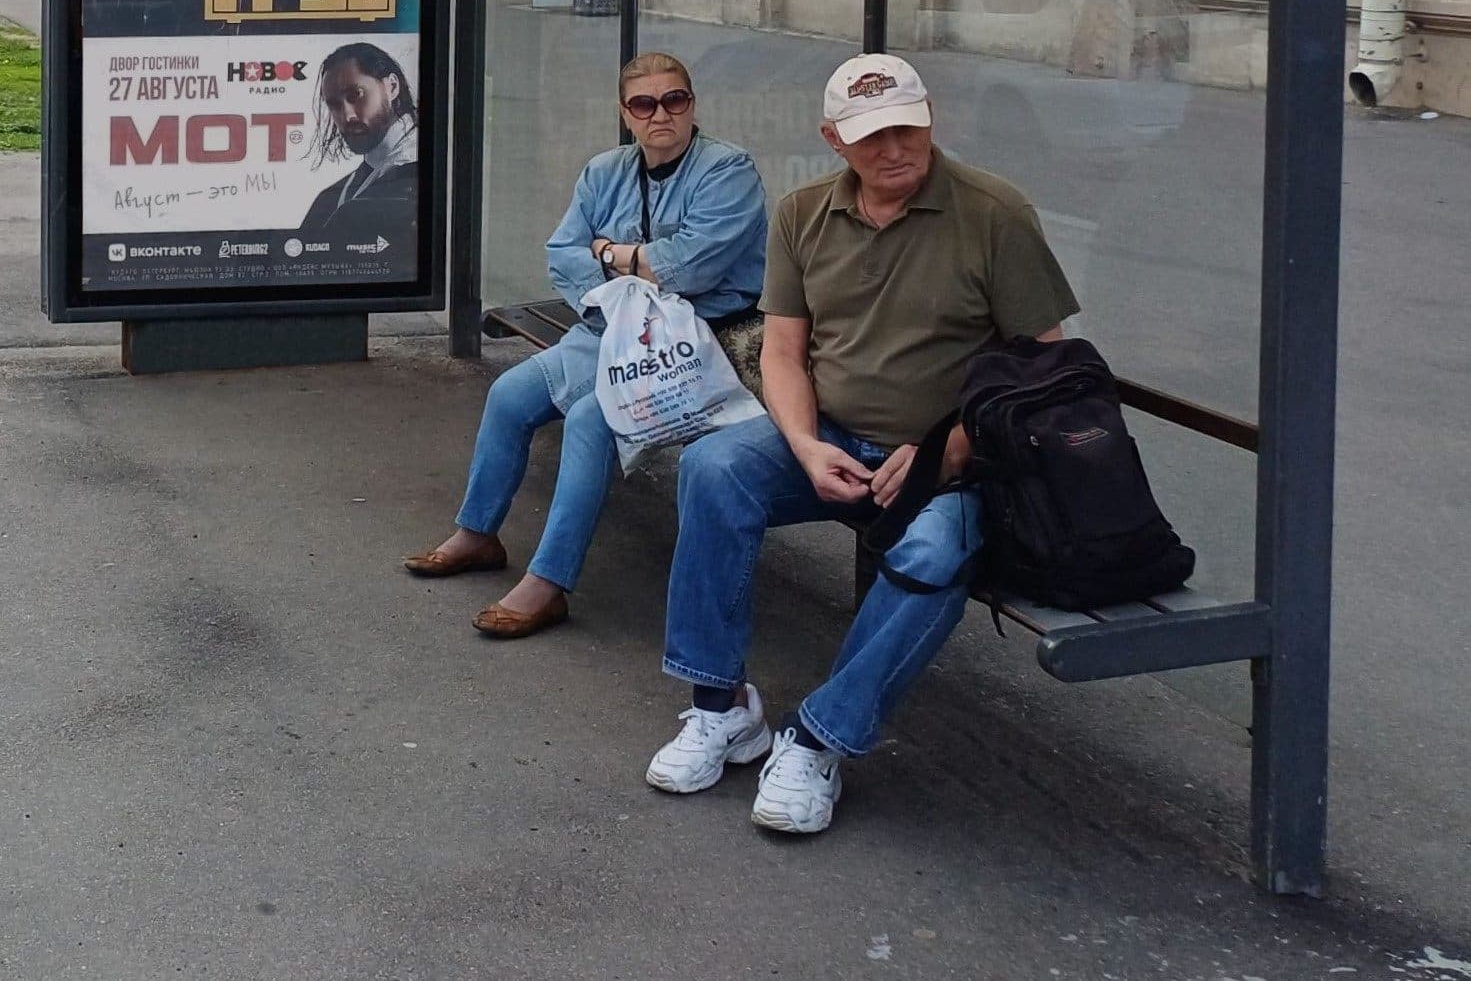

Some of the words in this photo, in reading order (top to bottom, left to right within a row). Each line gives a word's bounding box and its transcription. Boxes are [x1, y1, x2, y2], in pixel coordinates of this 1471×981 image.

[109, 57, 139, 72] ДВОР
[142, 56, 199, 70] ГОСТИНКИ
[109, 77, 132, 101] 27
[137, 76, 219, 100] АВГУСТА
[249, 87, 286, 95] РАДИО
[110, 112, 304, 166] МОТ
[114, 187, 180, 218] Август
[208, 185, 238, 200] это
[608, 341, 694, 385] maestro
[657, 358, 702, 382] woman
